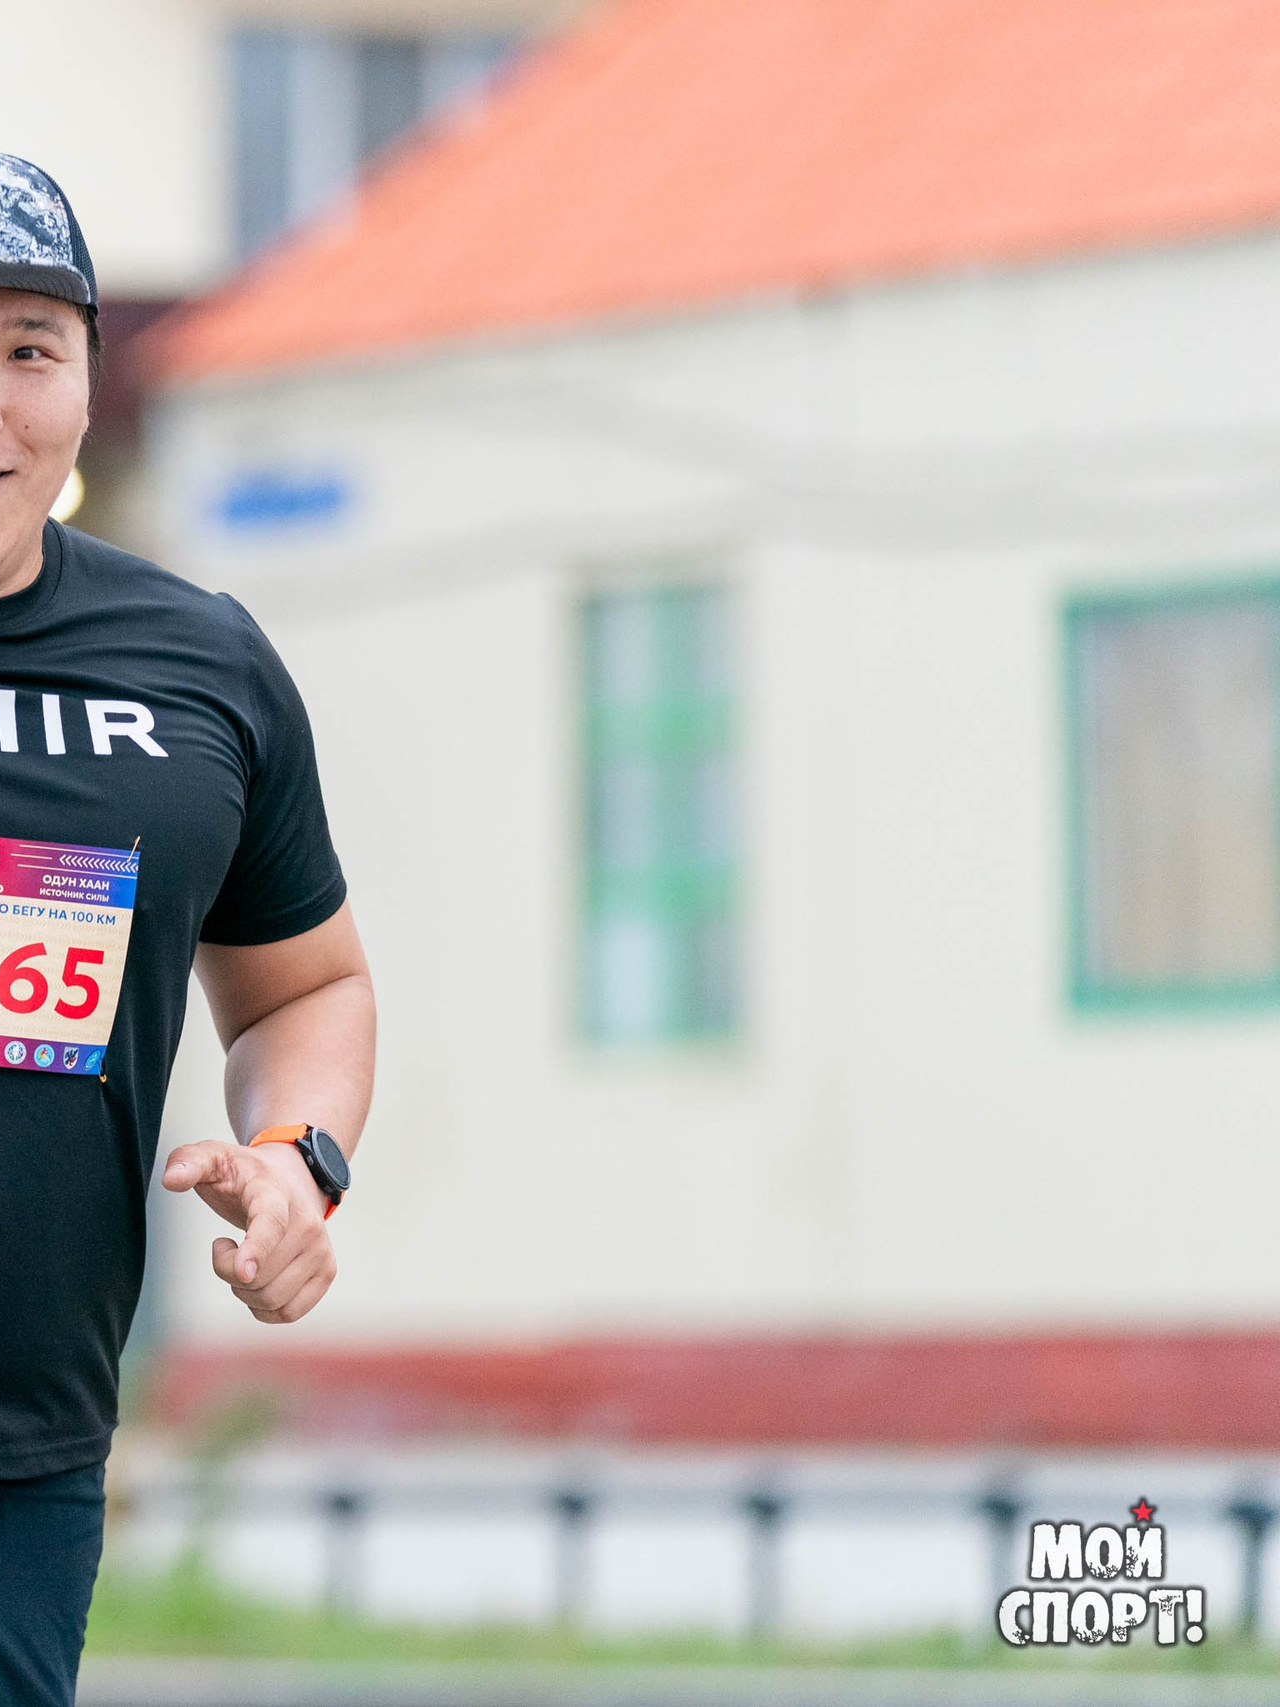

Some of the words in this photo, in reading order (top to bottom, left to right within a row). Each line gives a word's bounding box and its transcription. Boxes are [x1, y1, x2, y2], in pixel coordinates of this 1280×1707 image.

[43, 874, 77, 887] ОДУН
[79, 878, 110, 891] ХААН
[39, 887, 84, 900] ИСТОЧНИК
[85, 893, 110, 902] СИЛЫ
[13, 906, 45, 917] БЕГУ
[49, 909, 67, 920] НА
[71, 911, 93, 923] 100
[97, 914, 116, 925] КМ
